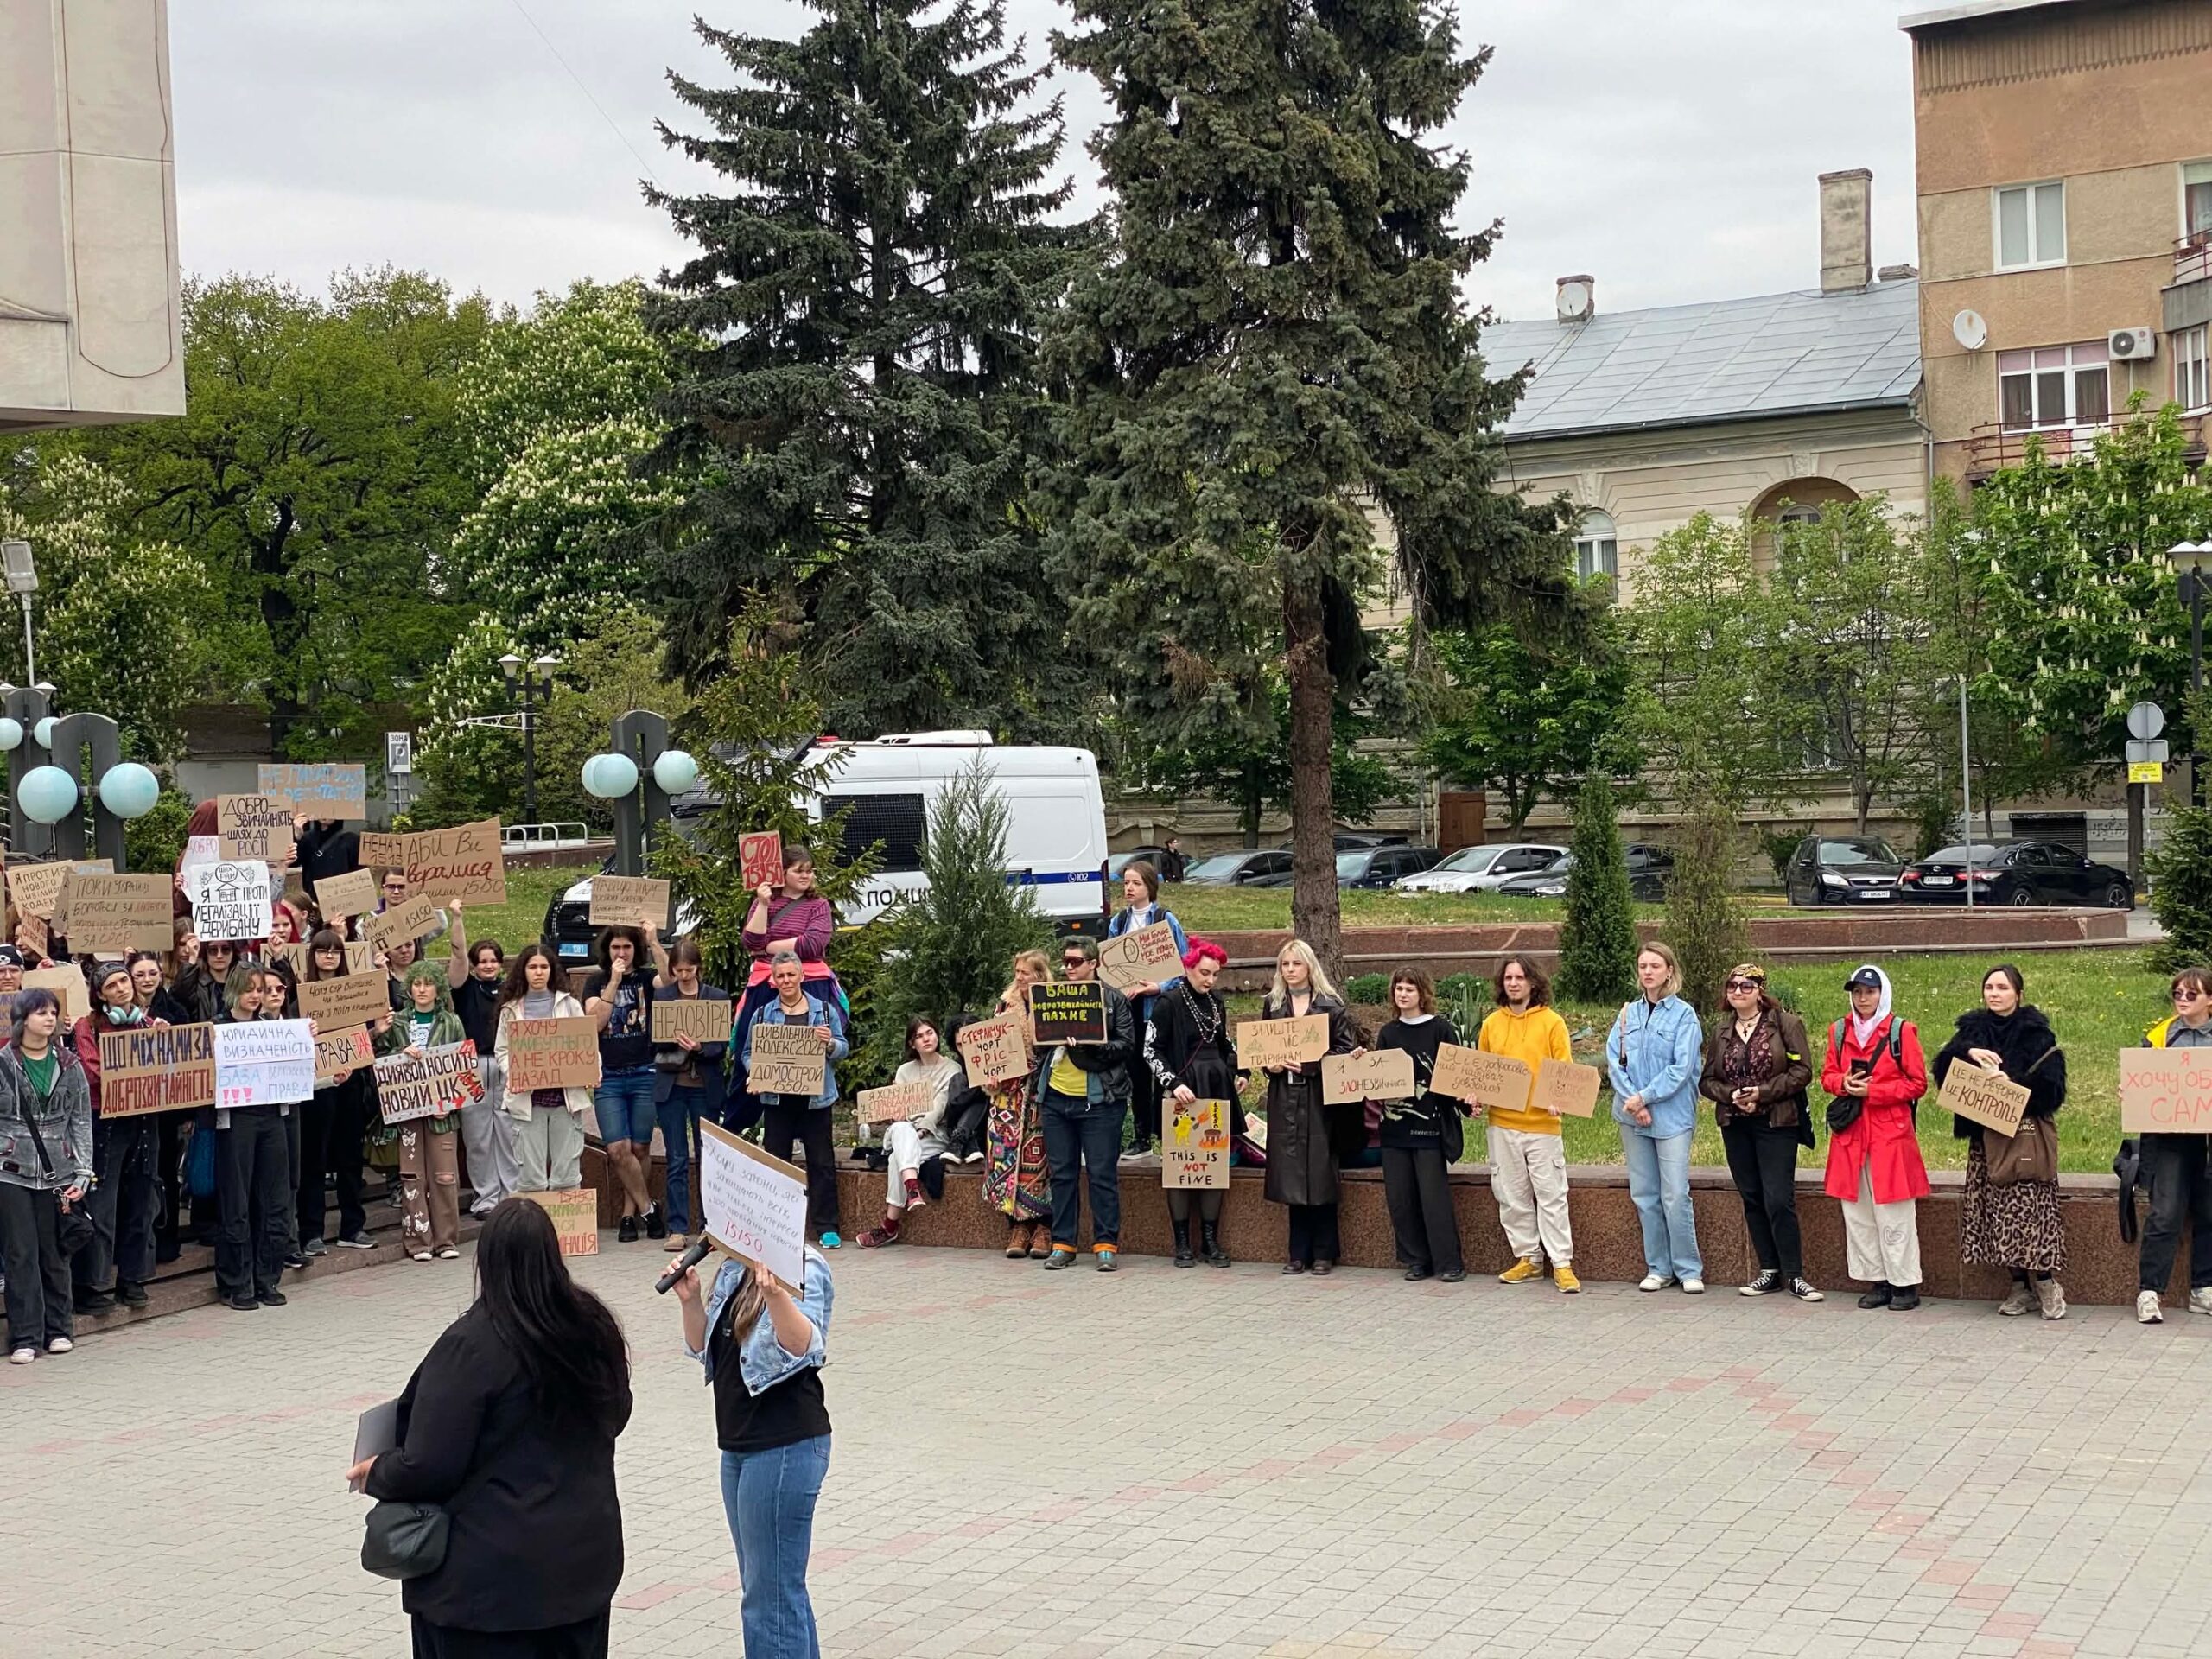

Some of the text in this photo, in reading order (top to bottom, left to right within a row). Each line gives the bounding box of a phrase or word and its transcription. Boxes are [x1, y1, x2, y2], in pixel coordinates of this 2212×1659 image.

[253, 828, 269, 840] ДО
[407, 834, 448, 864] АБИ
[15, 873, 22, 885] Я
[23, 867, 61, 882] ПРОТИ
[1077, 873, 1089, 881] 102
[22, 879, 57, 893] НОВОГО
[76, 878, 112, 899] ПОКИ
[200, 885, 269, 904] Я ПРОТИ
[200, 918, 261, 939] ДЕРИБАНУ
[1046, 983, 1089, 998] ВАША
[653, 1001, 730, 1039] НЕДОВІРА
[1041, 1009, 1088, 1022] ПАХНЕ
[221, 1027, 297, 1042] ЮРИДИЧНА
[509, 1019, 559, 1038] Я ХОЧУ
[102, 1034, 127, 1072] ЩО
[194, 1026, 213, 1061] ЗА
[976, 1039, 1001, 1052] ЧОРТ
[427, 1051, 480, 1078] НОСИТЬ
[510, 1051, 596, 1069] А НЕ КРОКУ
[2180, 1051, 2190, 1067] Я
[219, 1067, 262, 1088] БАЗА
[511, 1068, 563, 1088] НАЗАД
[751, 1064, 823, 1082] ДОМОСТРОЙ
[982, 1064, 1008, 1077] ЧОРТ
[103, 1068, 213, 1115] ДОБРОЗВИЧАЙНІСТЬ
[268, 1080, 310, 1101] ПРАВА
[1952, 1065, 2026, 1104] ЦЕ НЕ РЕФОРМА
[2126, 1071, 2179, 1096] ХОЧУ
[381, 1082, 433, 1116] НОВИЙ
[435, 1077, 463, 1103] ЦК
[877, 1087, 901, 1100] ХОЧУ
[1944, 1082, 2018, 1124] ЦЕ КОНТРОЛЬ
[1183, 1162, 1208, 1173] NOT
[723, 1219, 764, 1254] 15150
